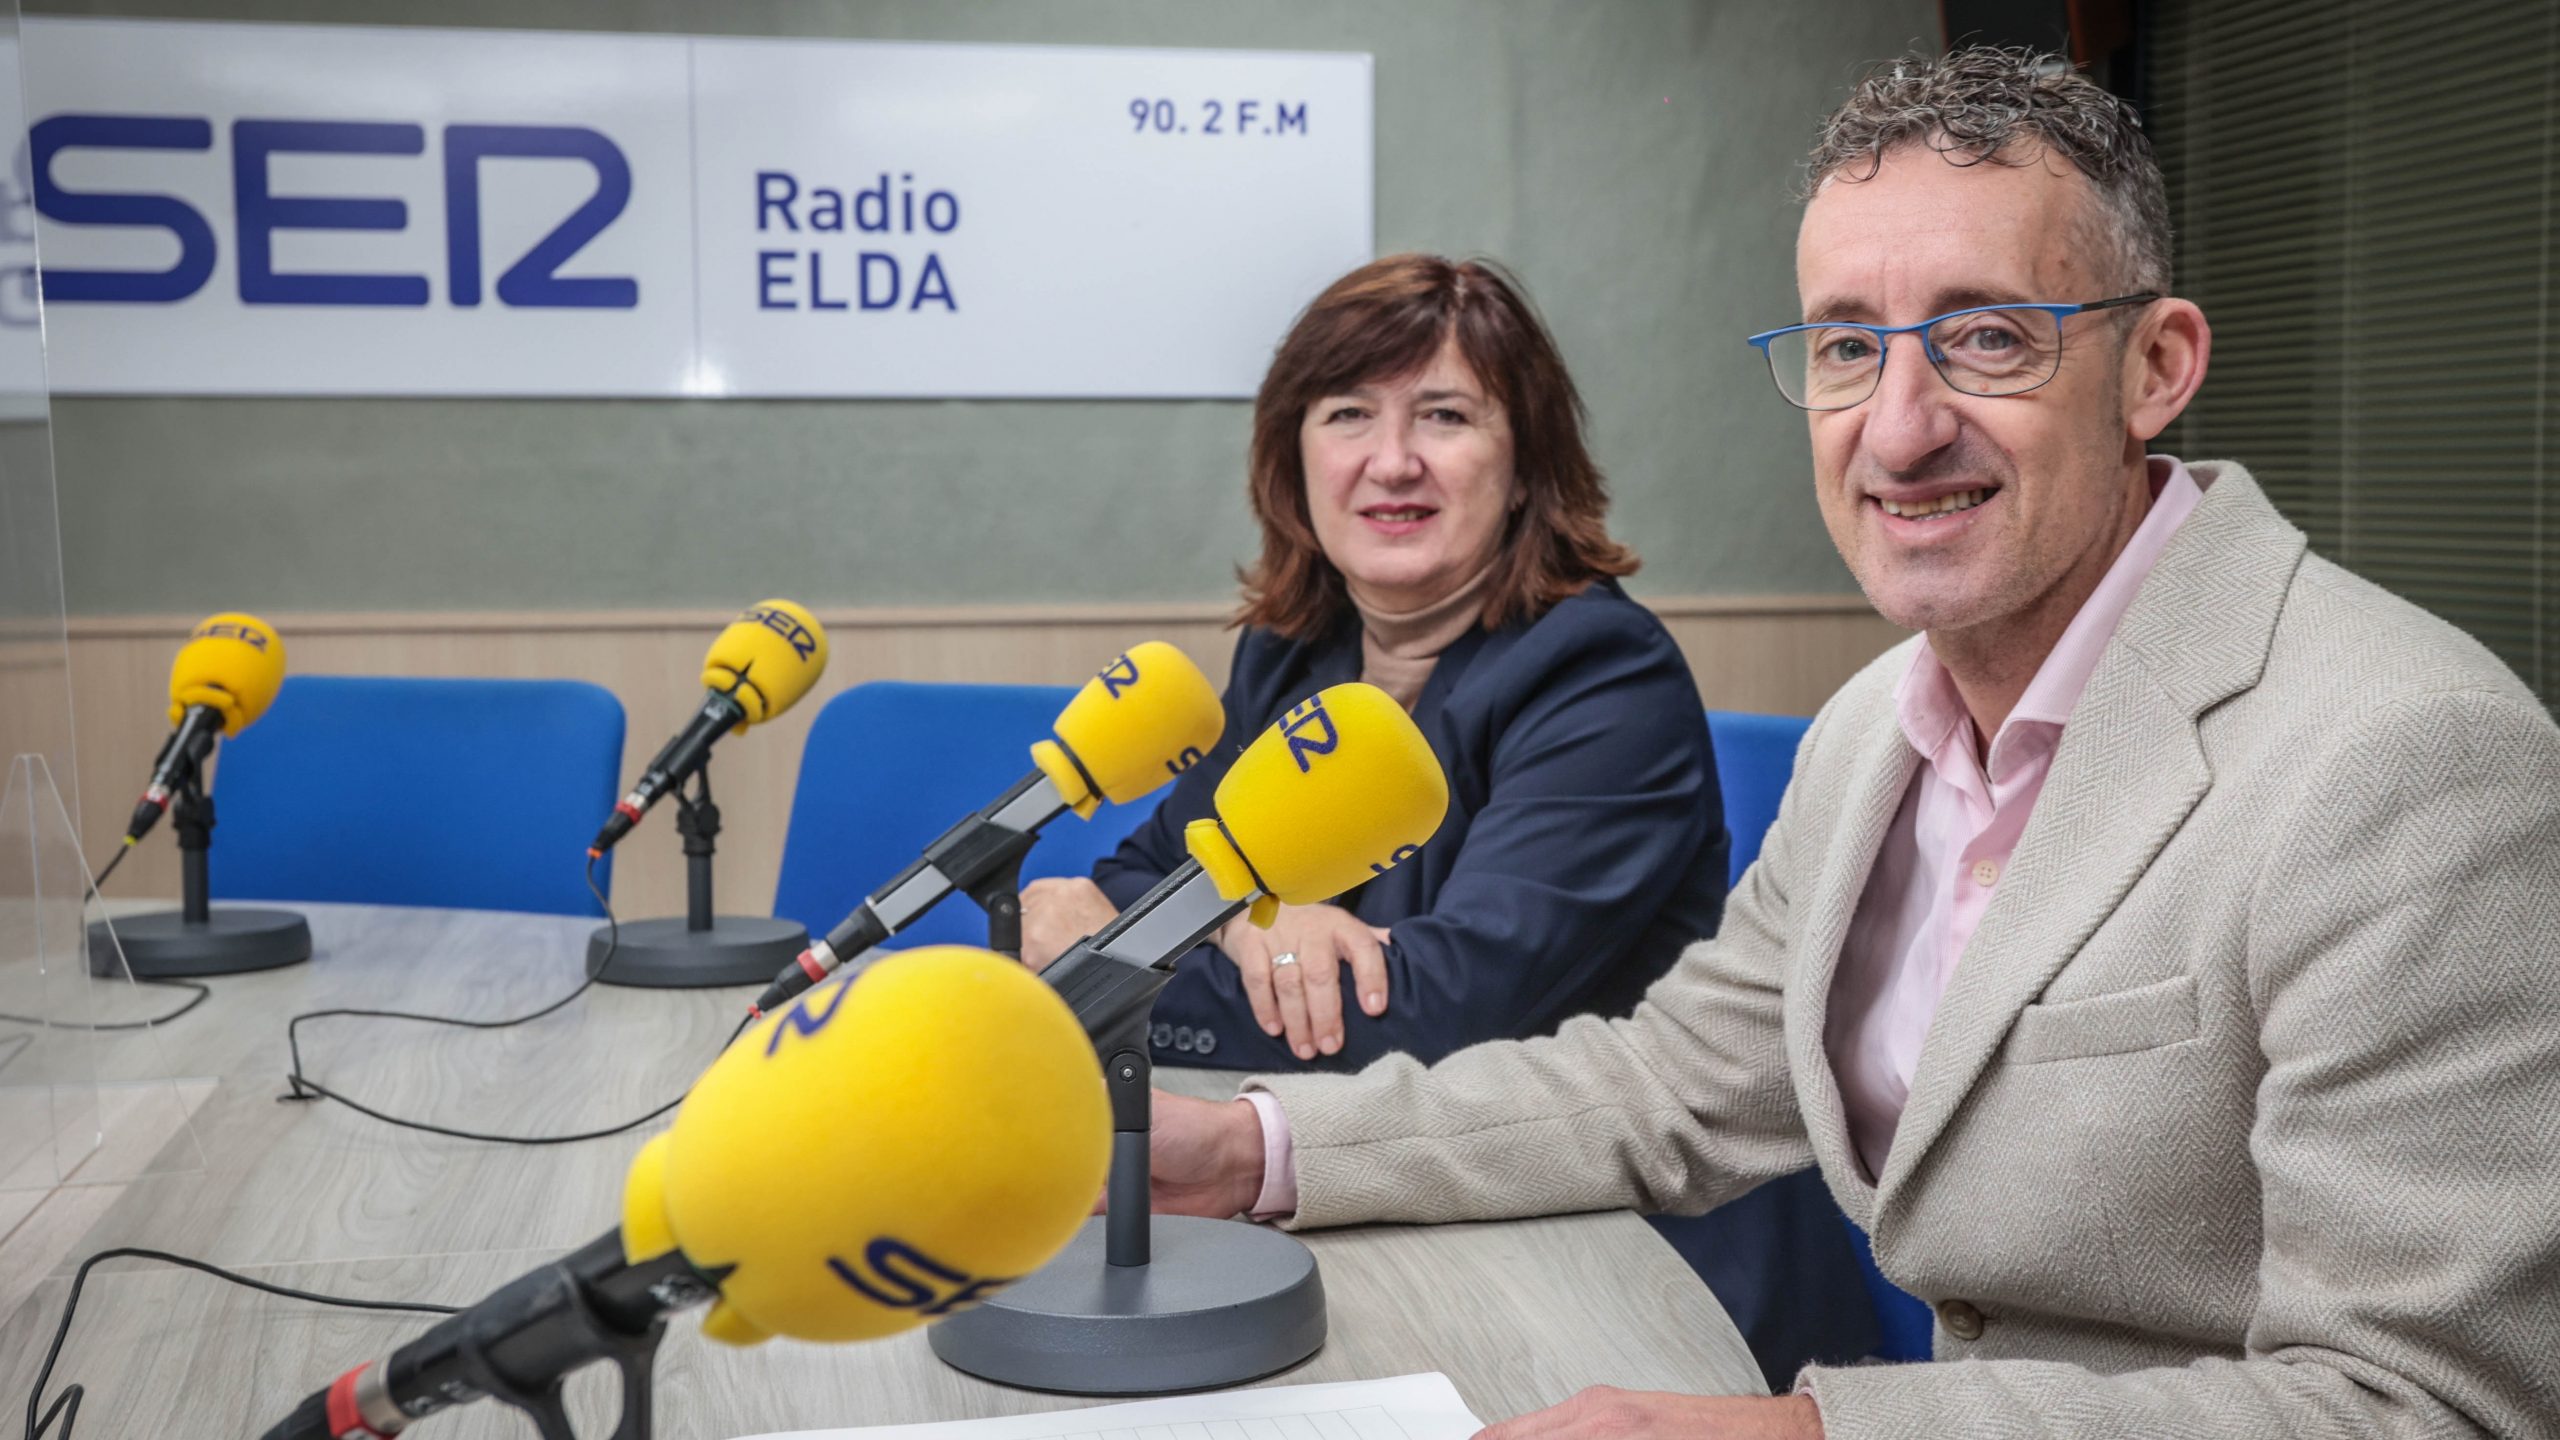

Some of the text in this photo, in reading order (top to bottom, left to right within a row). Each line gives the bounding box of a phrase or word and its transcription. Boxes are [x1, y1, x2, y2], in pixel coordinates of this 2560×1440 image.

[1236, 100, 1309, 136] F.M
[16, 113, 639, 309] SER
[756, 170, 960, 234] Radio
[758, 250, 958, 312] ELDA
